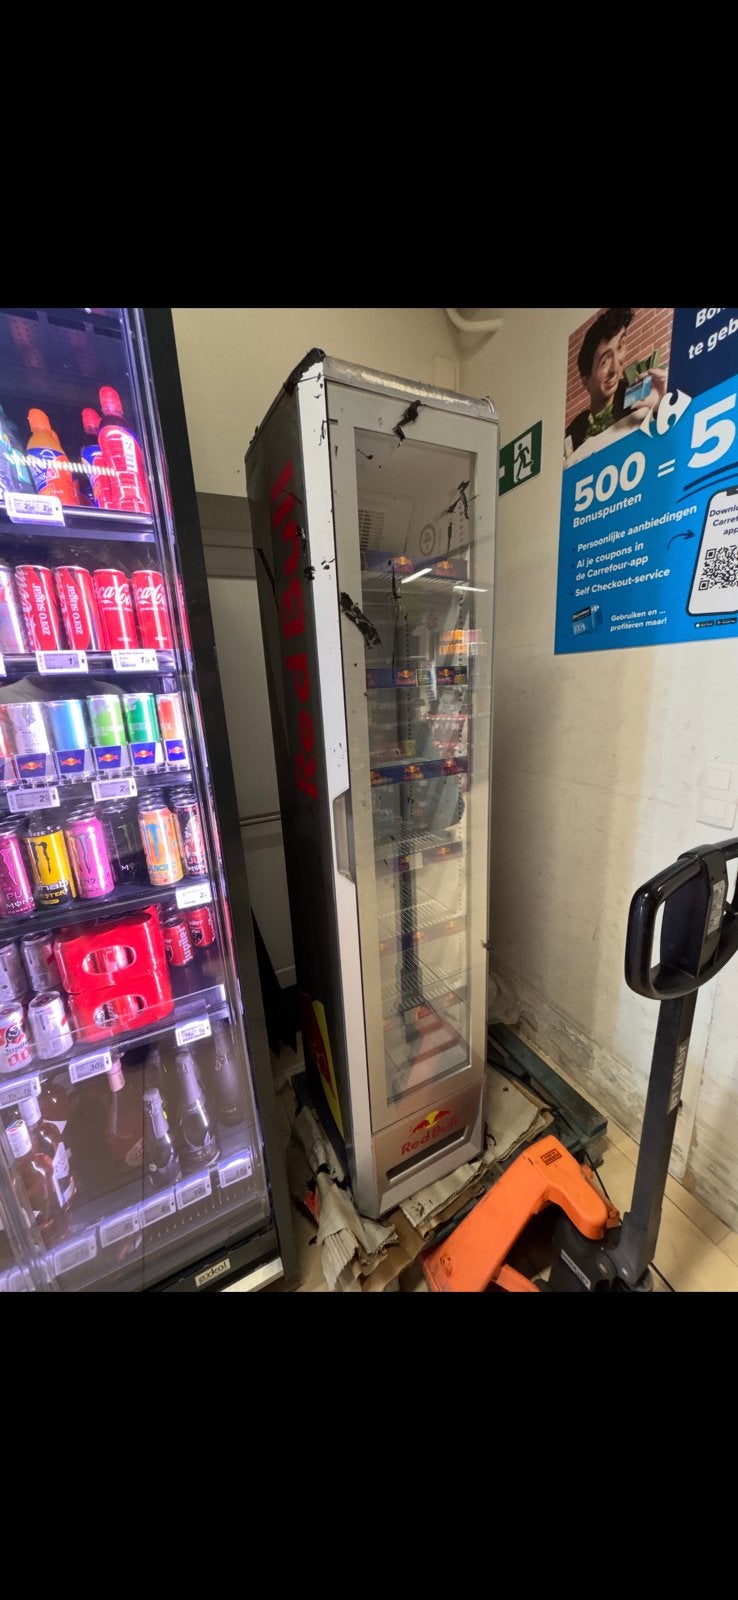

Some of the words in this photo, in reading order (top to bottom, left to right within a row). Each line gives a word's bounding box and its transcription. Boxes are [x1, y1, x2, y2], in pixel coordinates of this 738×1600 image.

[688, 341, 704, 360] te
[574, 451, 646, 512] 500
[573, 493, 643, 529] Bonuspunten
[577, 530, 626, 553] Persoonlijke
[627, 505, 698, 536] aanbiedingen
[270, 459, 306, 641] Bull
[576, 558, 586, 569] Al
[586, 555, 594, 567] je
[595, 547, 633, 566] coupons
[634, 541, 645, 552] in
[575, 571, 586, 581] de
[586, 555, 649, 578] Carrefour-app
[32, 583, 48, 612] sugar
[66, 583, 79, 612] sugar
[575, 586, 591, 598] Self
[591, 568, 671, 593] Checkout-service
[38, 612, 51, 636] zero
[72, 612, 84, 635] zero
[609, 620, 644, 633] profiteren
[645, 617, 668, 627] maar!
[610, 611, 646, 622] Gebruiken
[285, 652, 320, 802] Red
[400, 1131, 430, 1156] Red
[430, 1115, 460, 1139] Bull
[198, 1261, 228, 1284] exkal
